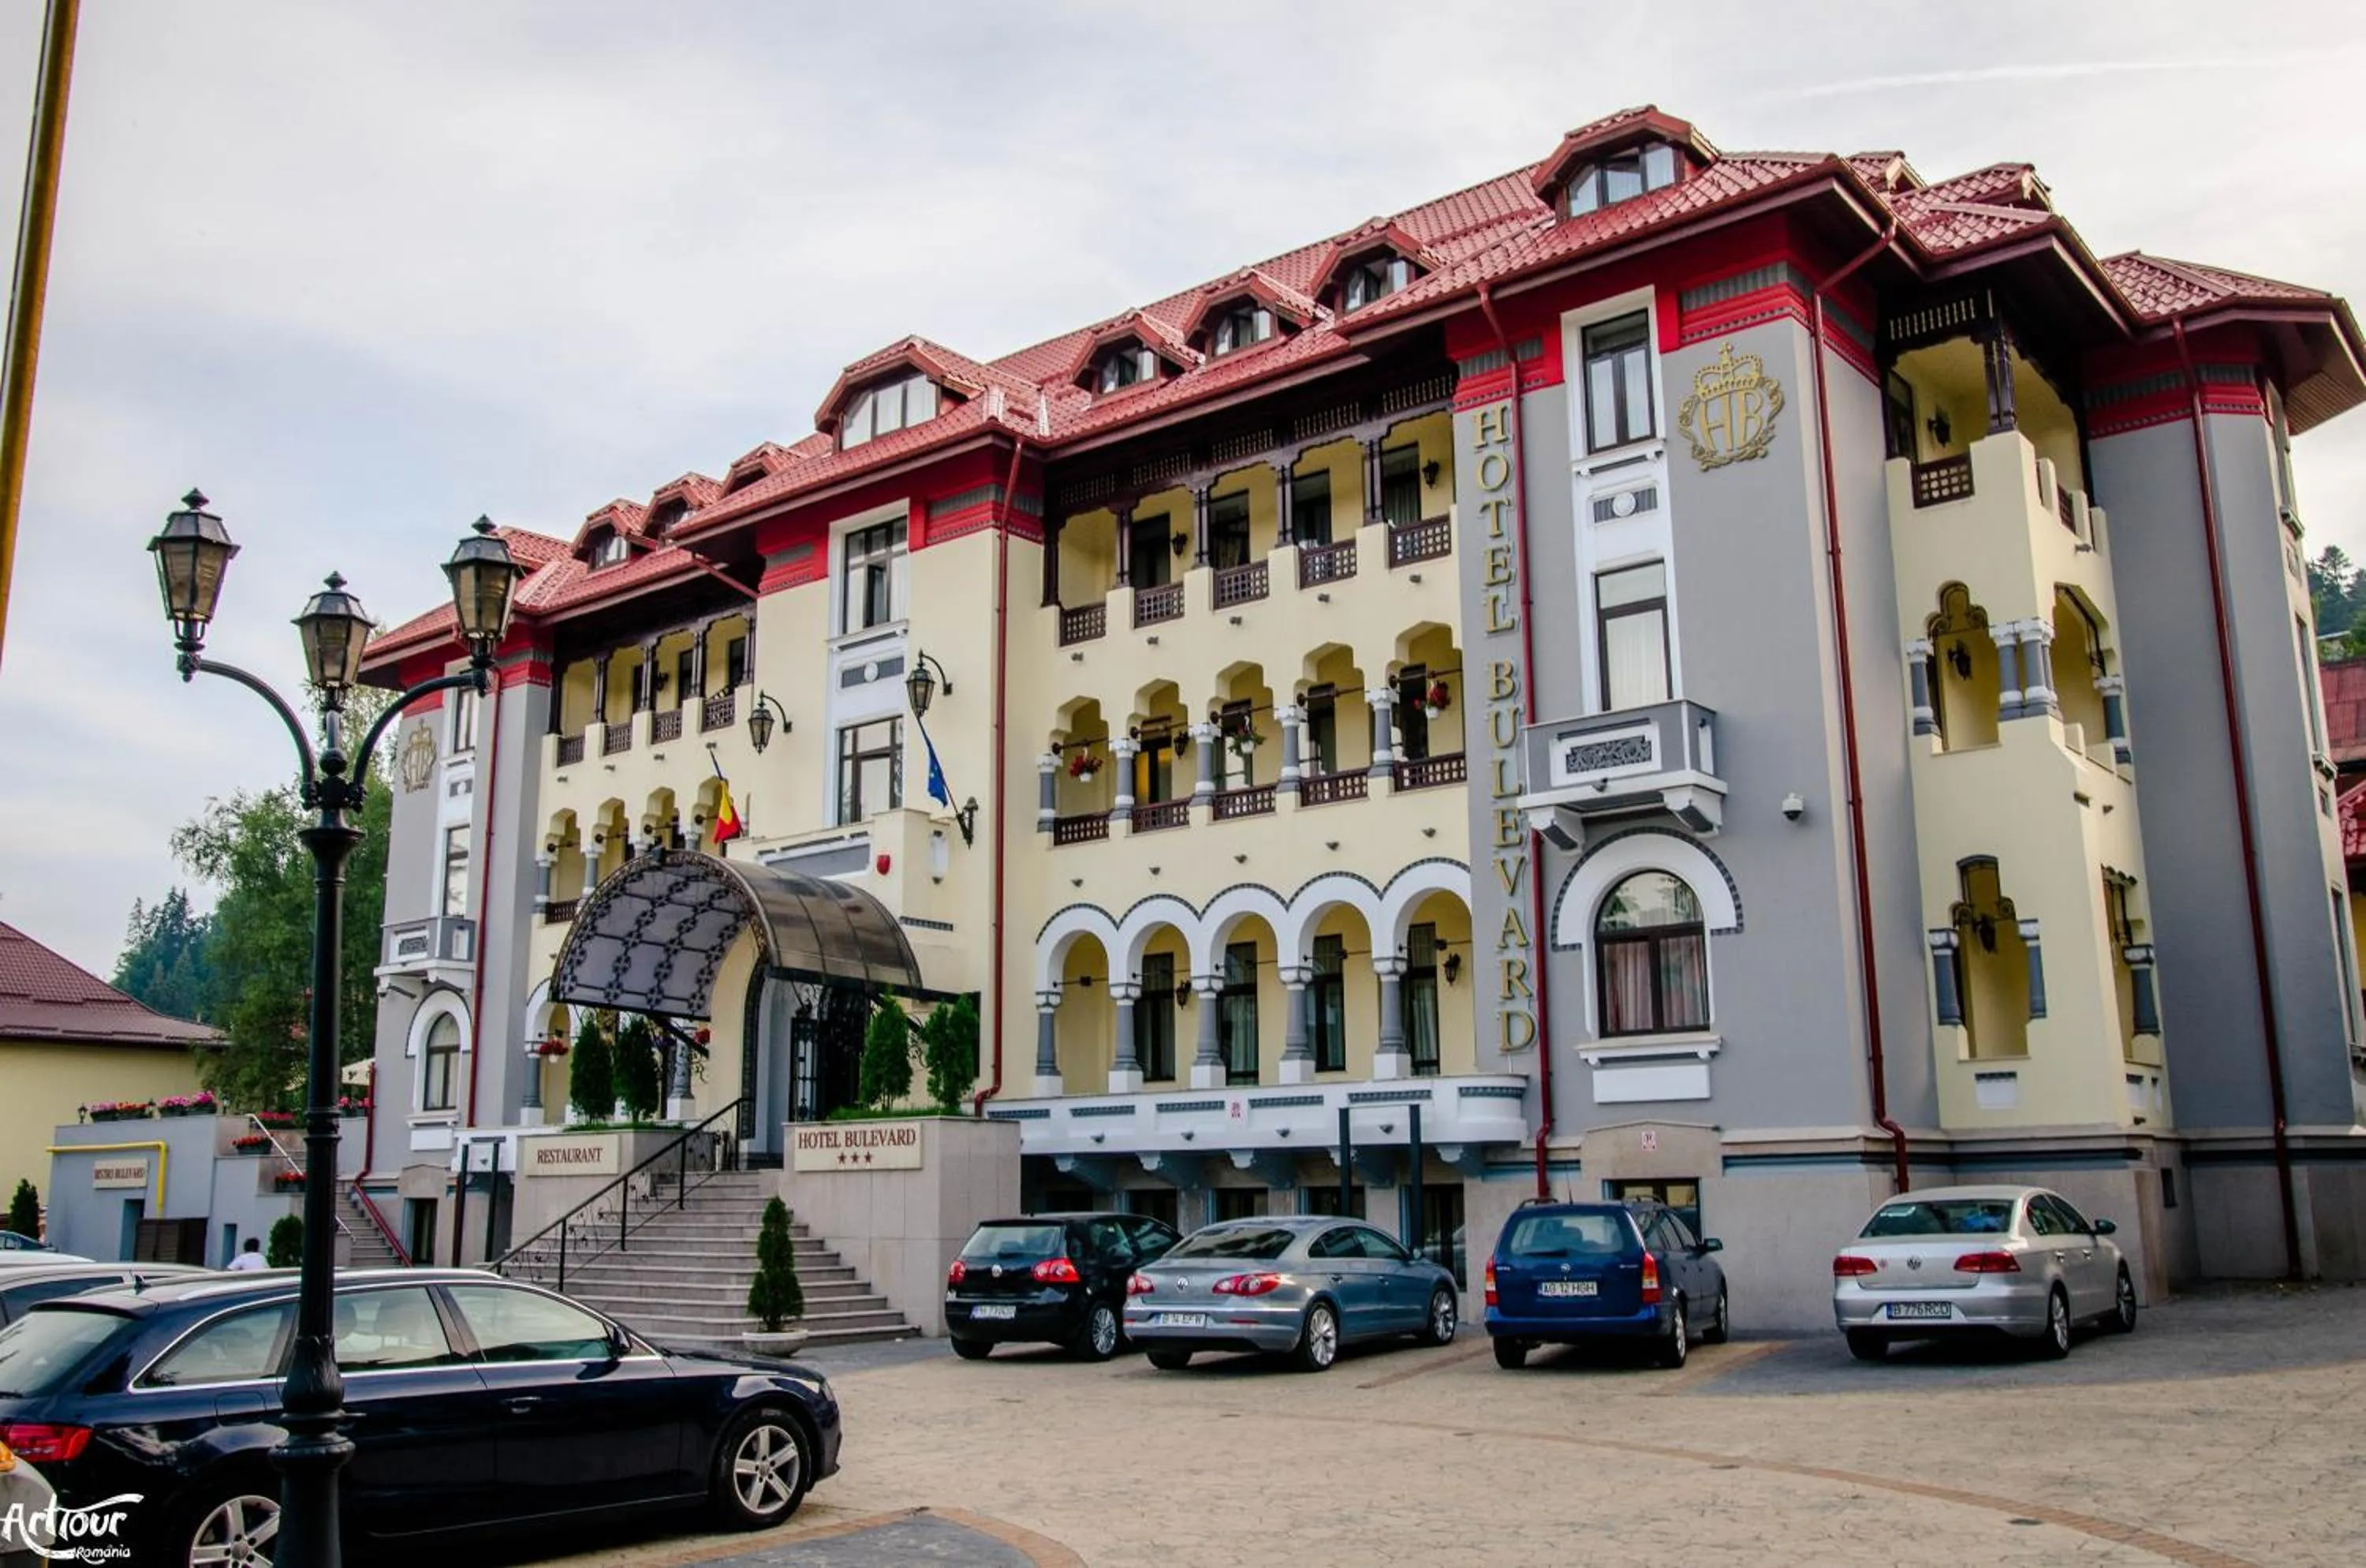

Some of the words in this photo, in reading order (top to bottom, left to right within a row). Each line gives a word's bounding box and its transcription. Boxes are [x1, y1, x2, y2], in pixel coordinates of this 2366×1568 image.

[1473, 405, 1515, 635] HOTEL
[1487, 659, 1536, 1054] BULEVARD
[537, 1148, 603, 1164] RESTAURANT
[798, 1130, 842, 1149] HOTEL
[845, 1129, 916, 1148] BULEVARD
